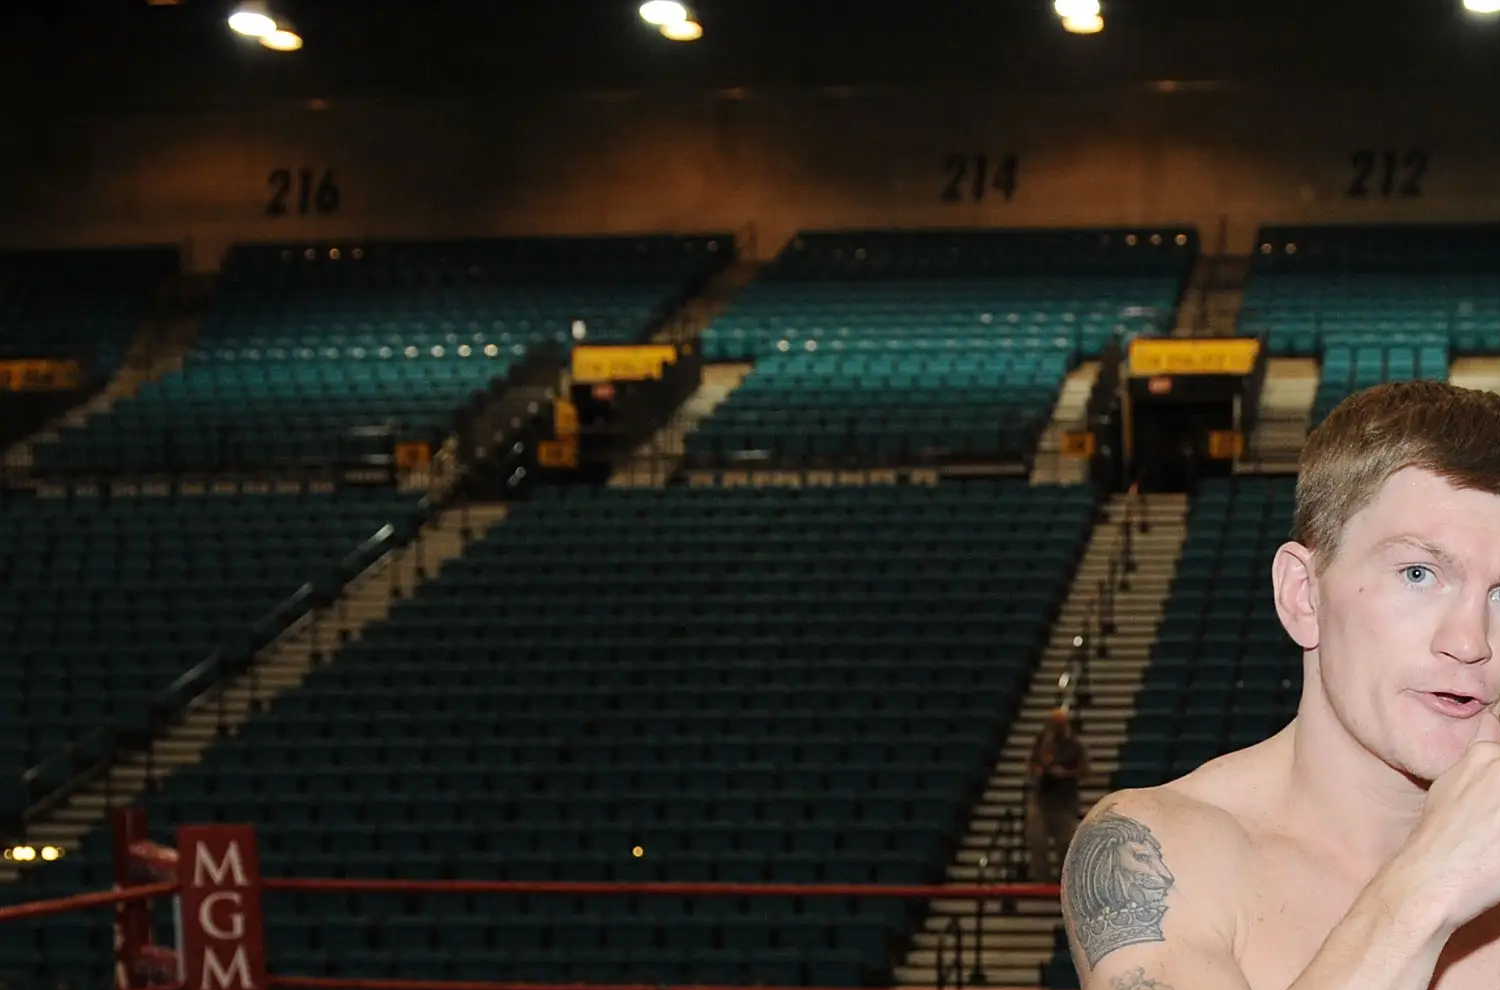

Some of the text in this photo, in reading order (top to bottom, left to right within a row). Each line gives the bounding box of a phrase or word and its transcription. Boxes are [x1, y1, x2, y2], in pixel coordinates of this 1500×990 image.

[264, 167, 340, 217] 216
[939, 150, 1020, 202] 214
[1345, 148, 1430, 197] 212
